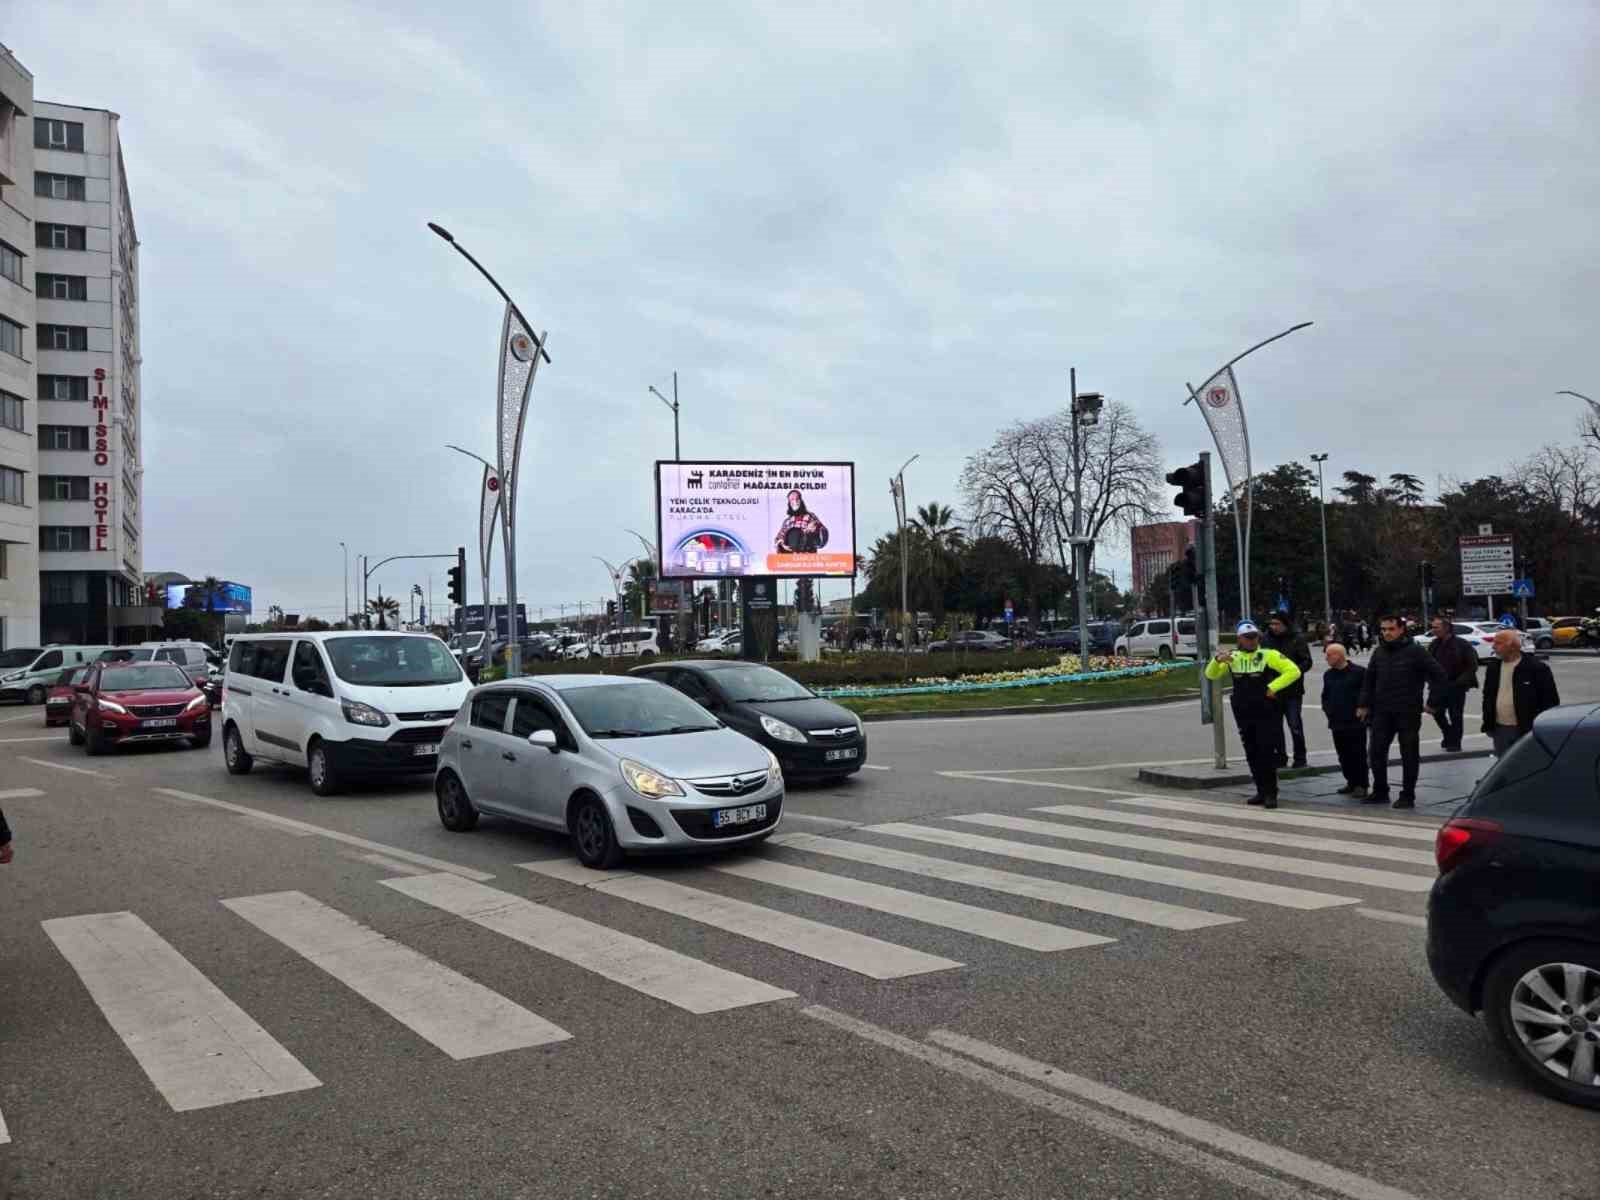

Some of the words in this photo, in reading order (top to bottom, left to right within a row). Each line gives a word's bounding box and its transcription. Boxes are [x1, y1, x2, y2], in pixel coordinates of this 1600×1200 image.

[779, 470, 792, 478] EN
[94, 482, 109, 552] HOTEL
[719, 809, 730, 823] 55
